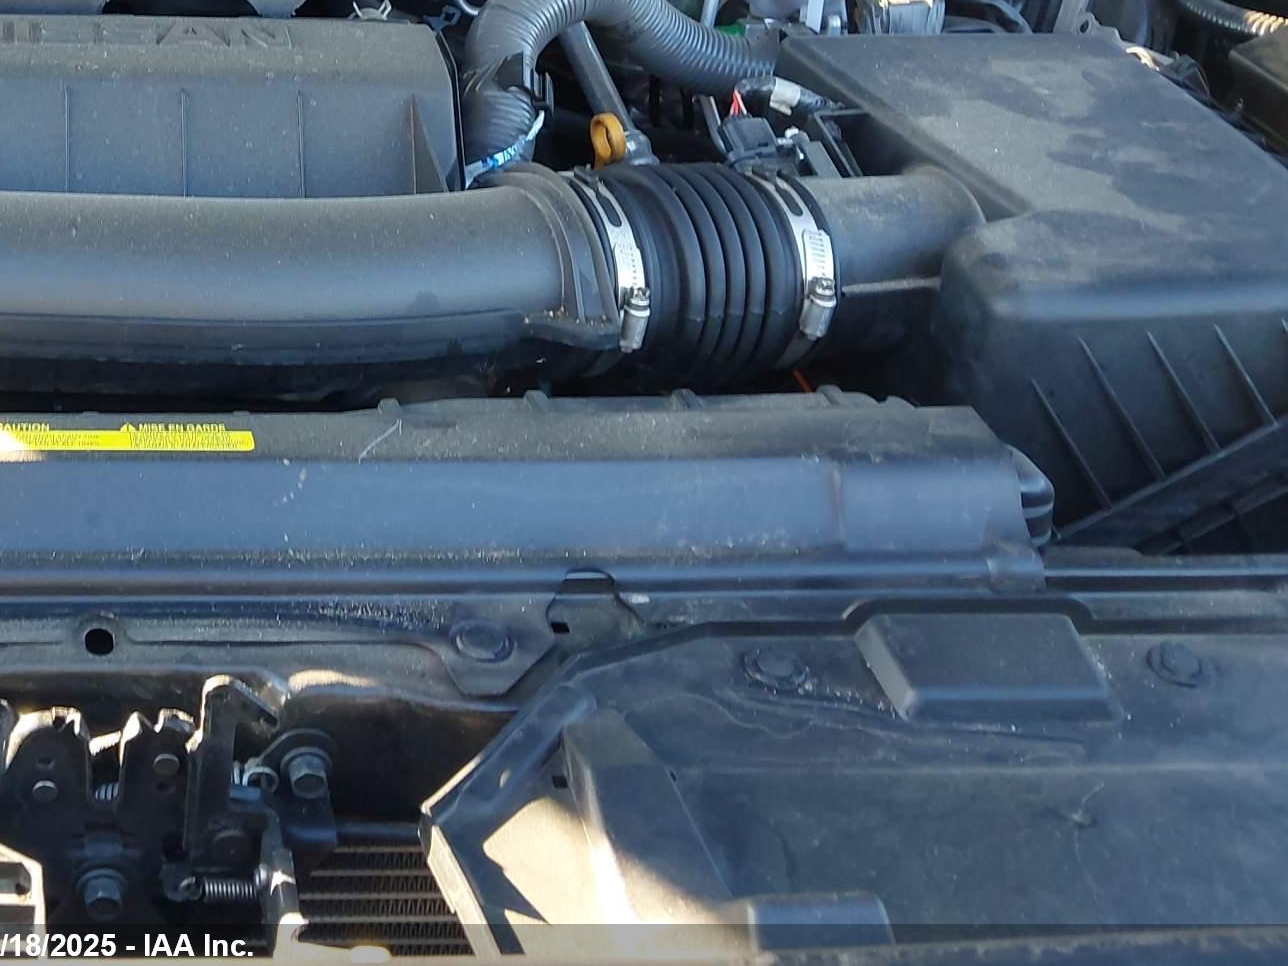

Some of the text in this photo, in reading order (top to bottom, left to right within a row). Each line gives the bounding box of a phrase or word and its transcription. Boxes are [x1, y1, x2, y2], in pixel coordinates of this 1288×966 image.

[138, 423, 226, 433] MISE EN GARDE
